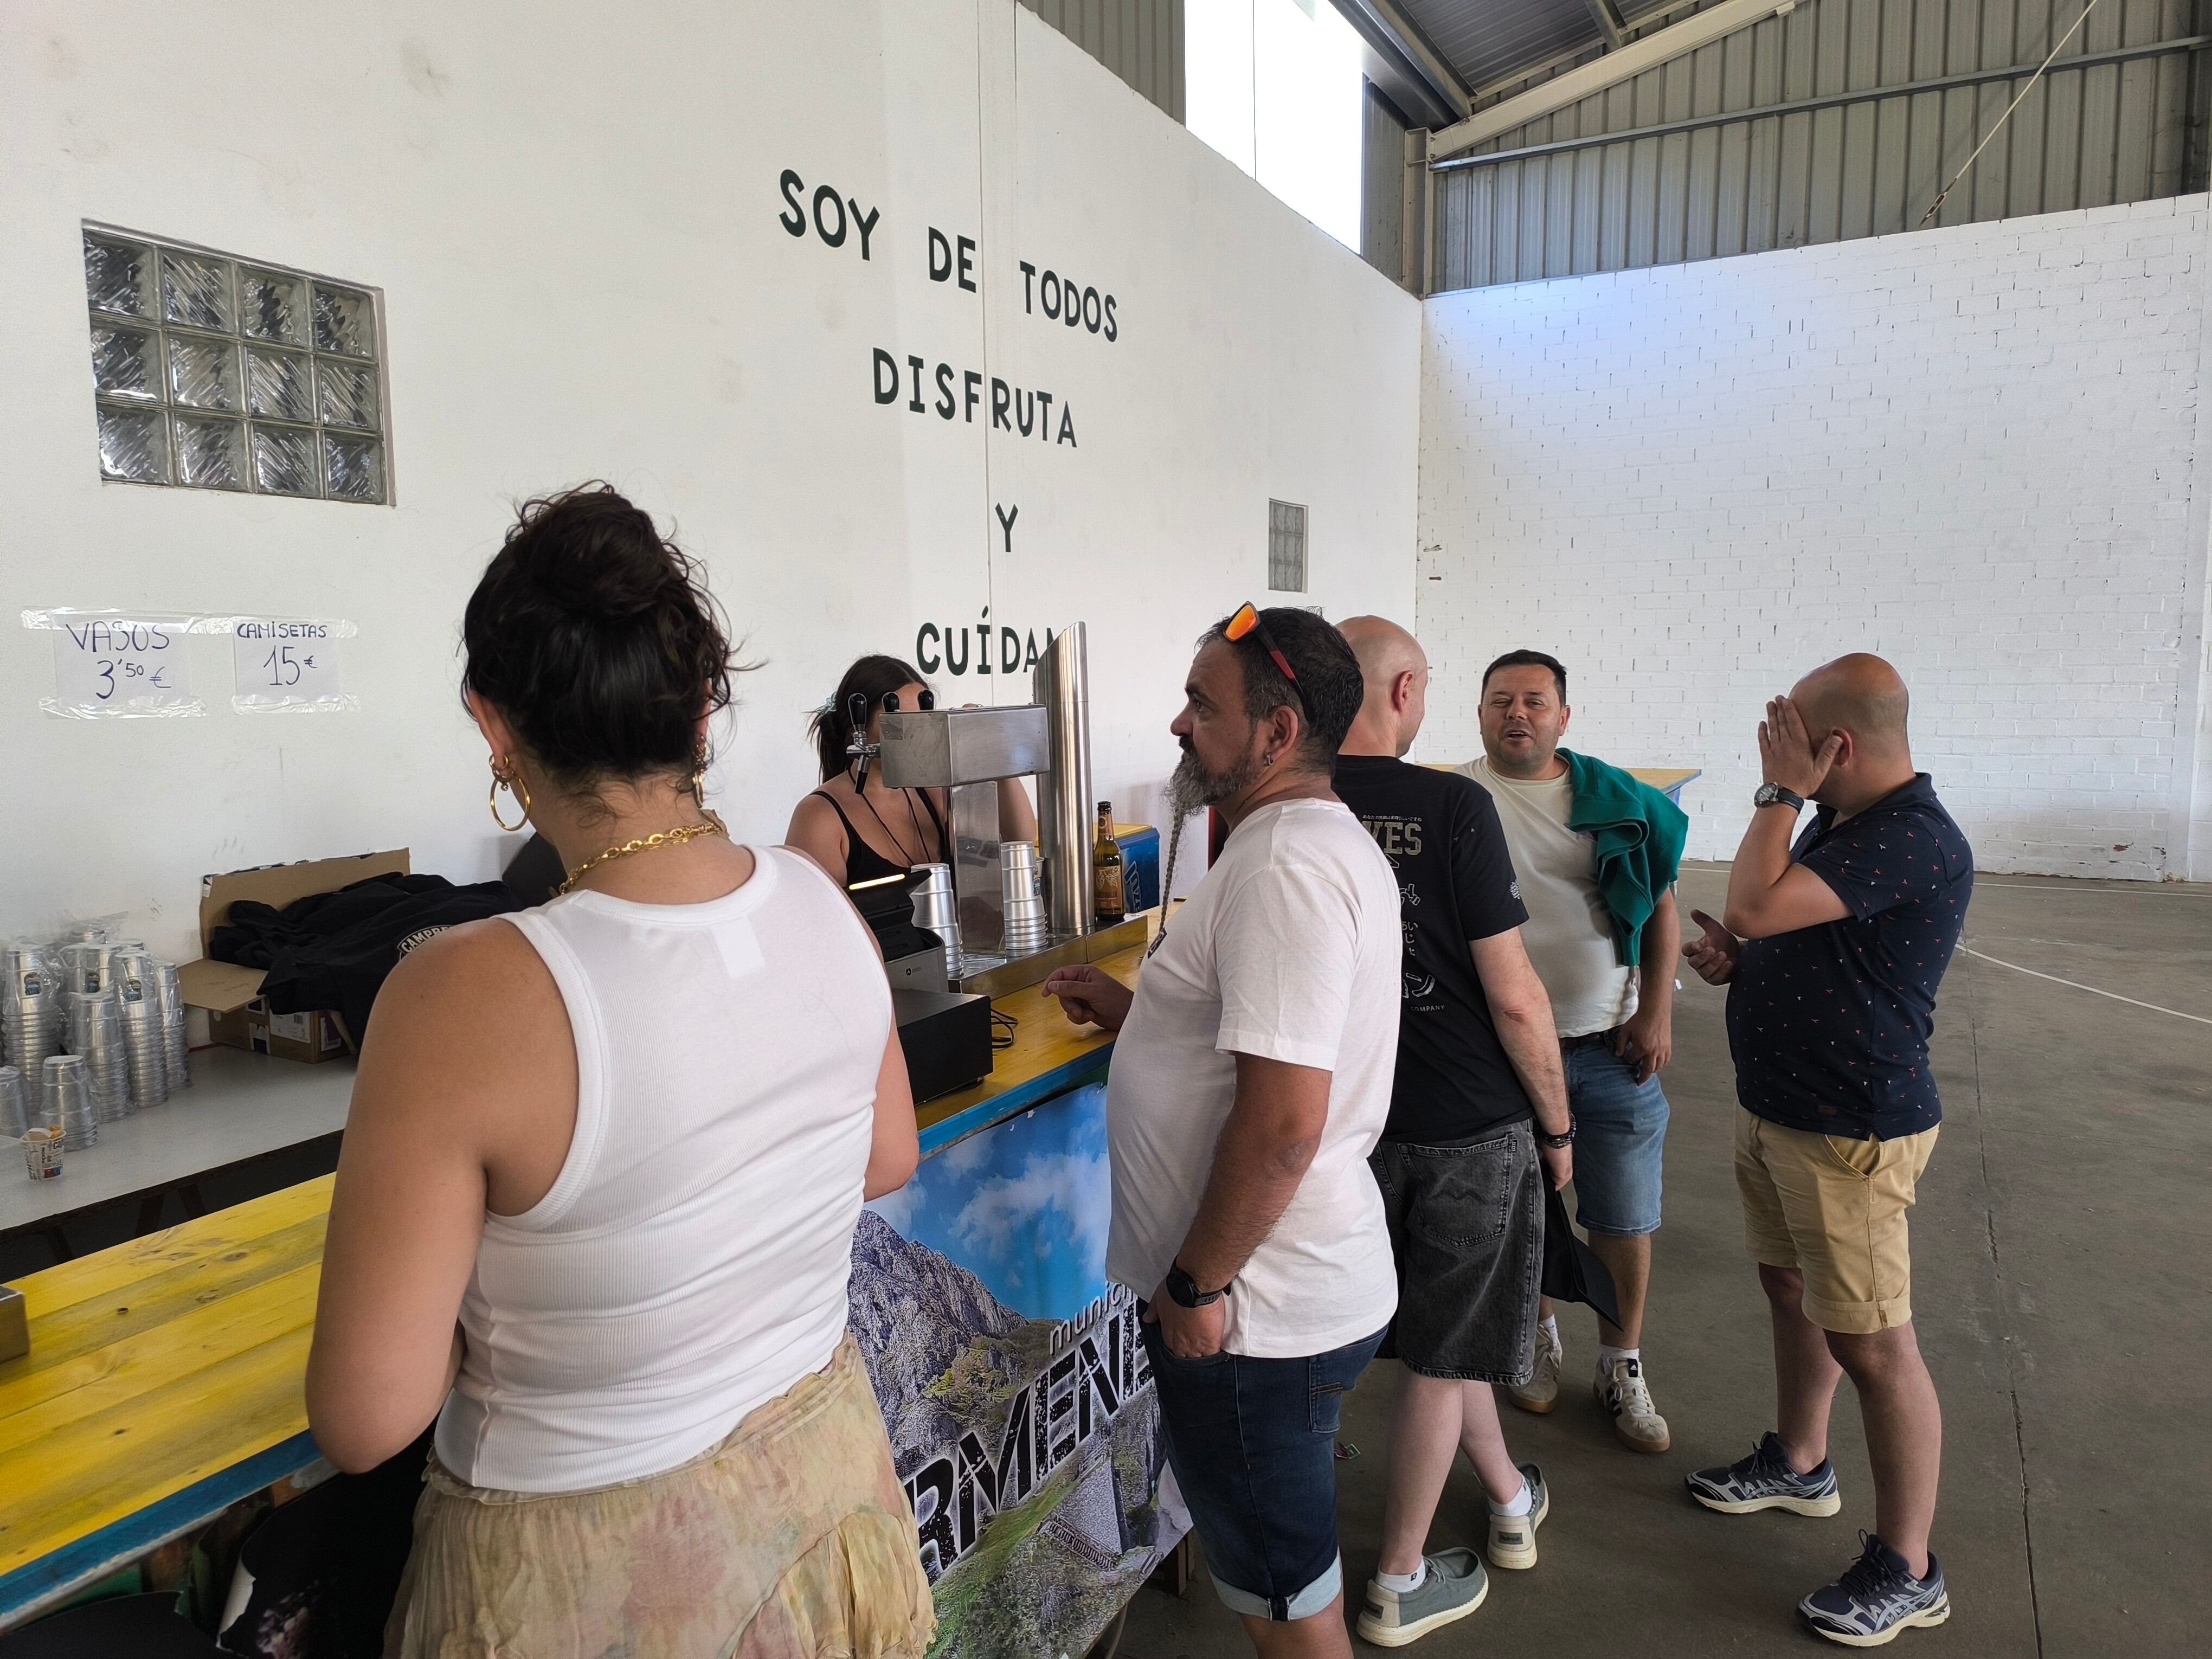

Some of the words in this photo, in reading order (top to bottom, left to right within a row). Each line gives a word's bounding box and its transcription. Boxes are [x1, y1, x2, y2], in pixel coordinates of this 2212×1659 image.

[779, 170, 879, 261] SOY
[928, 227, 976, 293] DE
[1020, 260, 1117, 342] TODOS
[873, 348, 1077, 448] DISFRUTA
[995, 503, 1018, 552] Y
[237, 621, 327, 639] CAMISETAS
